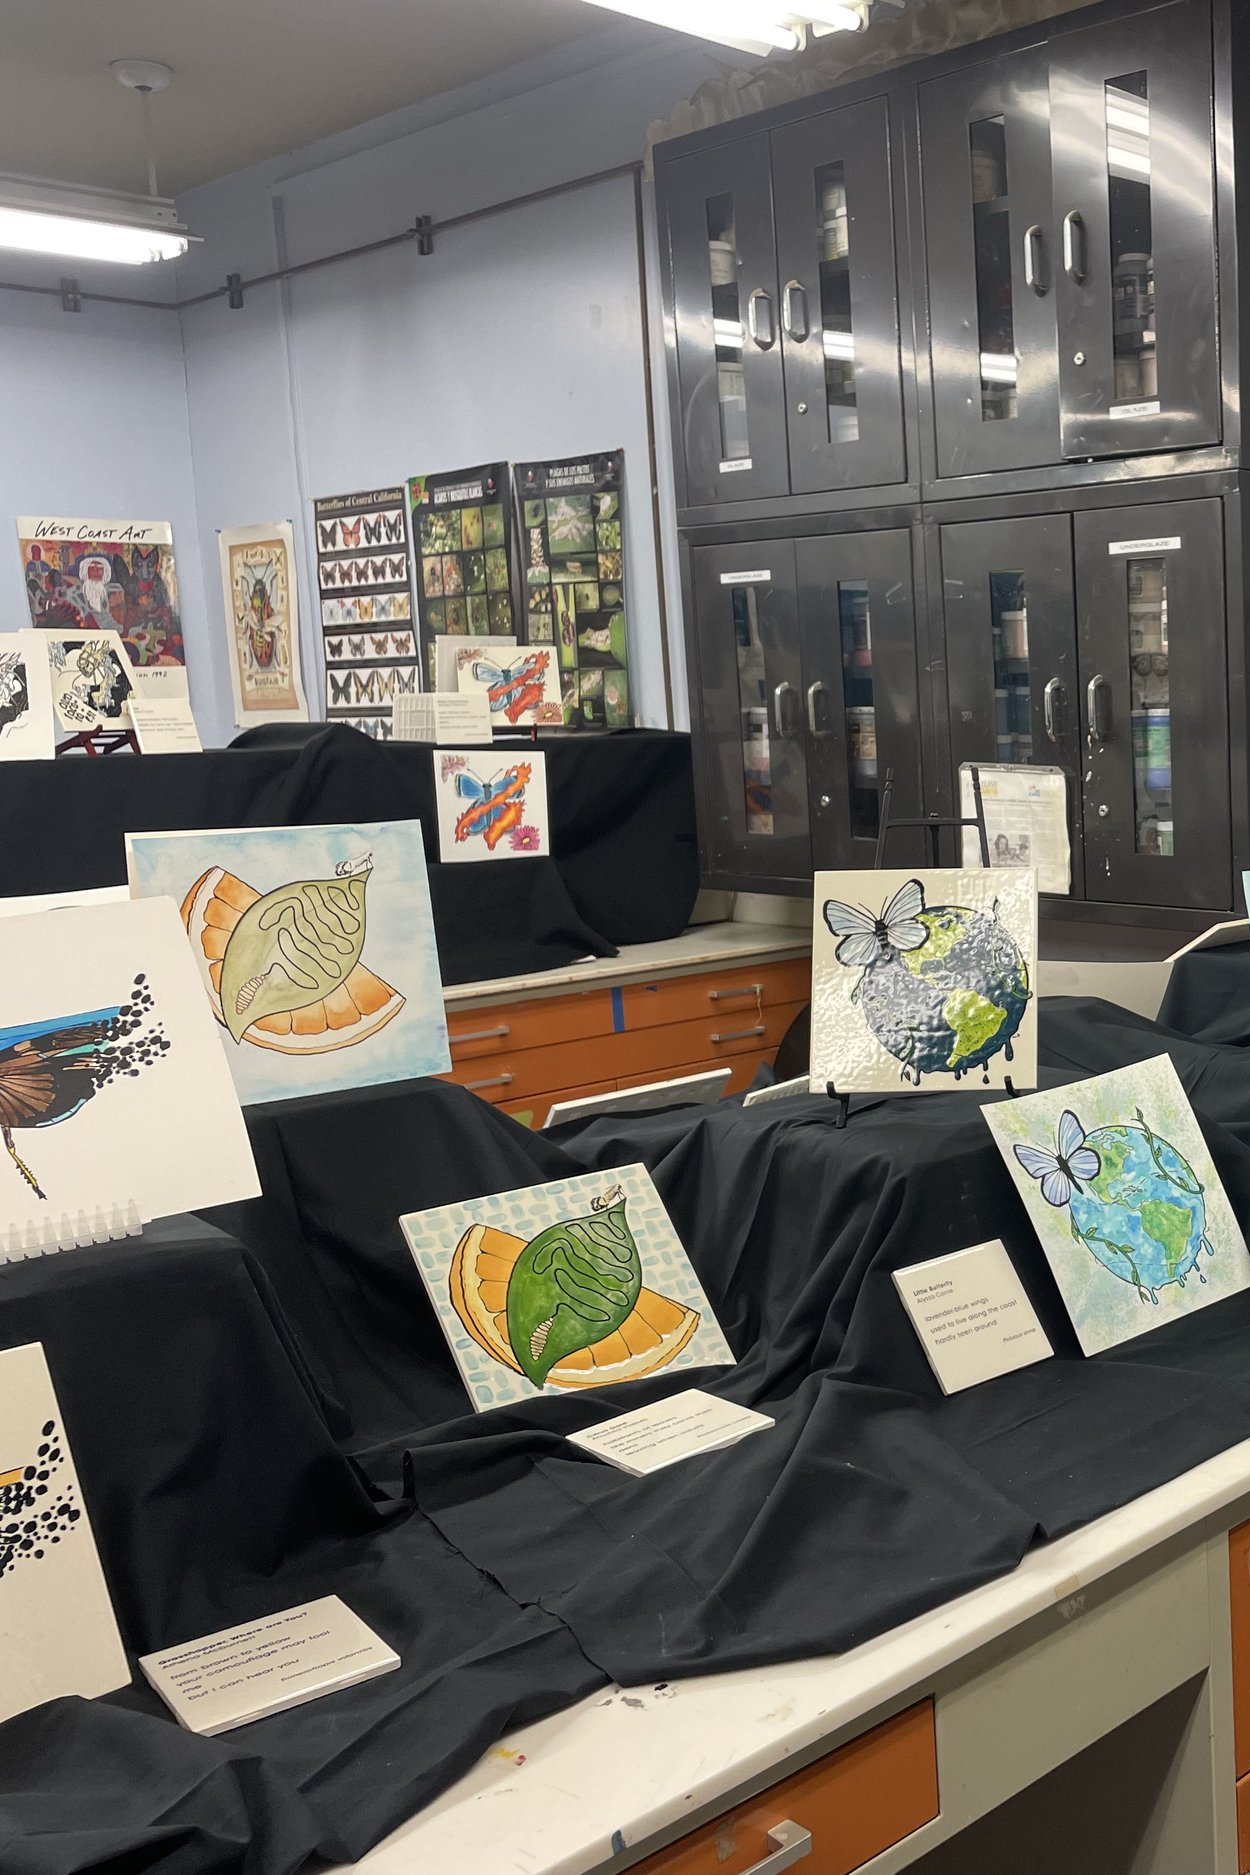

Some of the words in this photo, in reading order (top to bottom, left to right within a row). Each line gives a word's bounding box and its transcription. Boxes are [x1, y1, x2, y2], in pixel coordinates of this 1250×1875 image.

[317, 499, 344, 512] Butterflies
[345, 497, 352, 507] of
[352, 494, 372, 506] Central
[373, 490, 402, 502] California
[912, 1287, 928, 1297] Little
[928, 1280, 953, 1292] Butterfly
[916, 1294, 935, 1304] Alyssa
[924, 1302, 970, 1323] lavender-blue
[970, 1296, 989, 1308] wings
[929, 1323, 947, 1334] used
[955, 1316, 967, 1325] live
[968, 1311, 988, 1323] along
[987, 1306, 999, 1314] the
[999, 1299, 1018, 1311] coast
[934, 1334, 956, 1346] hardly
[956, 1328, 974, 1338] seen
[974, 1319, 998, 1332] around
[1023, 1327, 1037, 1336] anna
[158, 1639, 227, 1666] Grasshopper,
[229, 1626, 263, 1641] Where
[266, 1620, 283, 1629] are
[284, 1611, 308, 1622] You?
[170, 1667, 198, 1681] from
[200, 1655, 238, 1670] brown
[240, 1648, 253, 1657] to
[255, 1635, 292, 1653] yellow
[176, 1675, 203, 1688] your
[206, 1649, 279, 1678] camouflage
[280, 1638, 306, 1651] may
[309, 1630, 331, 1641] fool
[182, 1684, 203, 1695] me
[187, 1690, 209, 1701] but
[219, 1678, 244, 1690] can
[246, 1666, 275, 1680] hear
[277, 1658, 300, 1671] you
